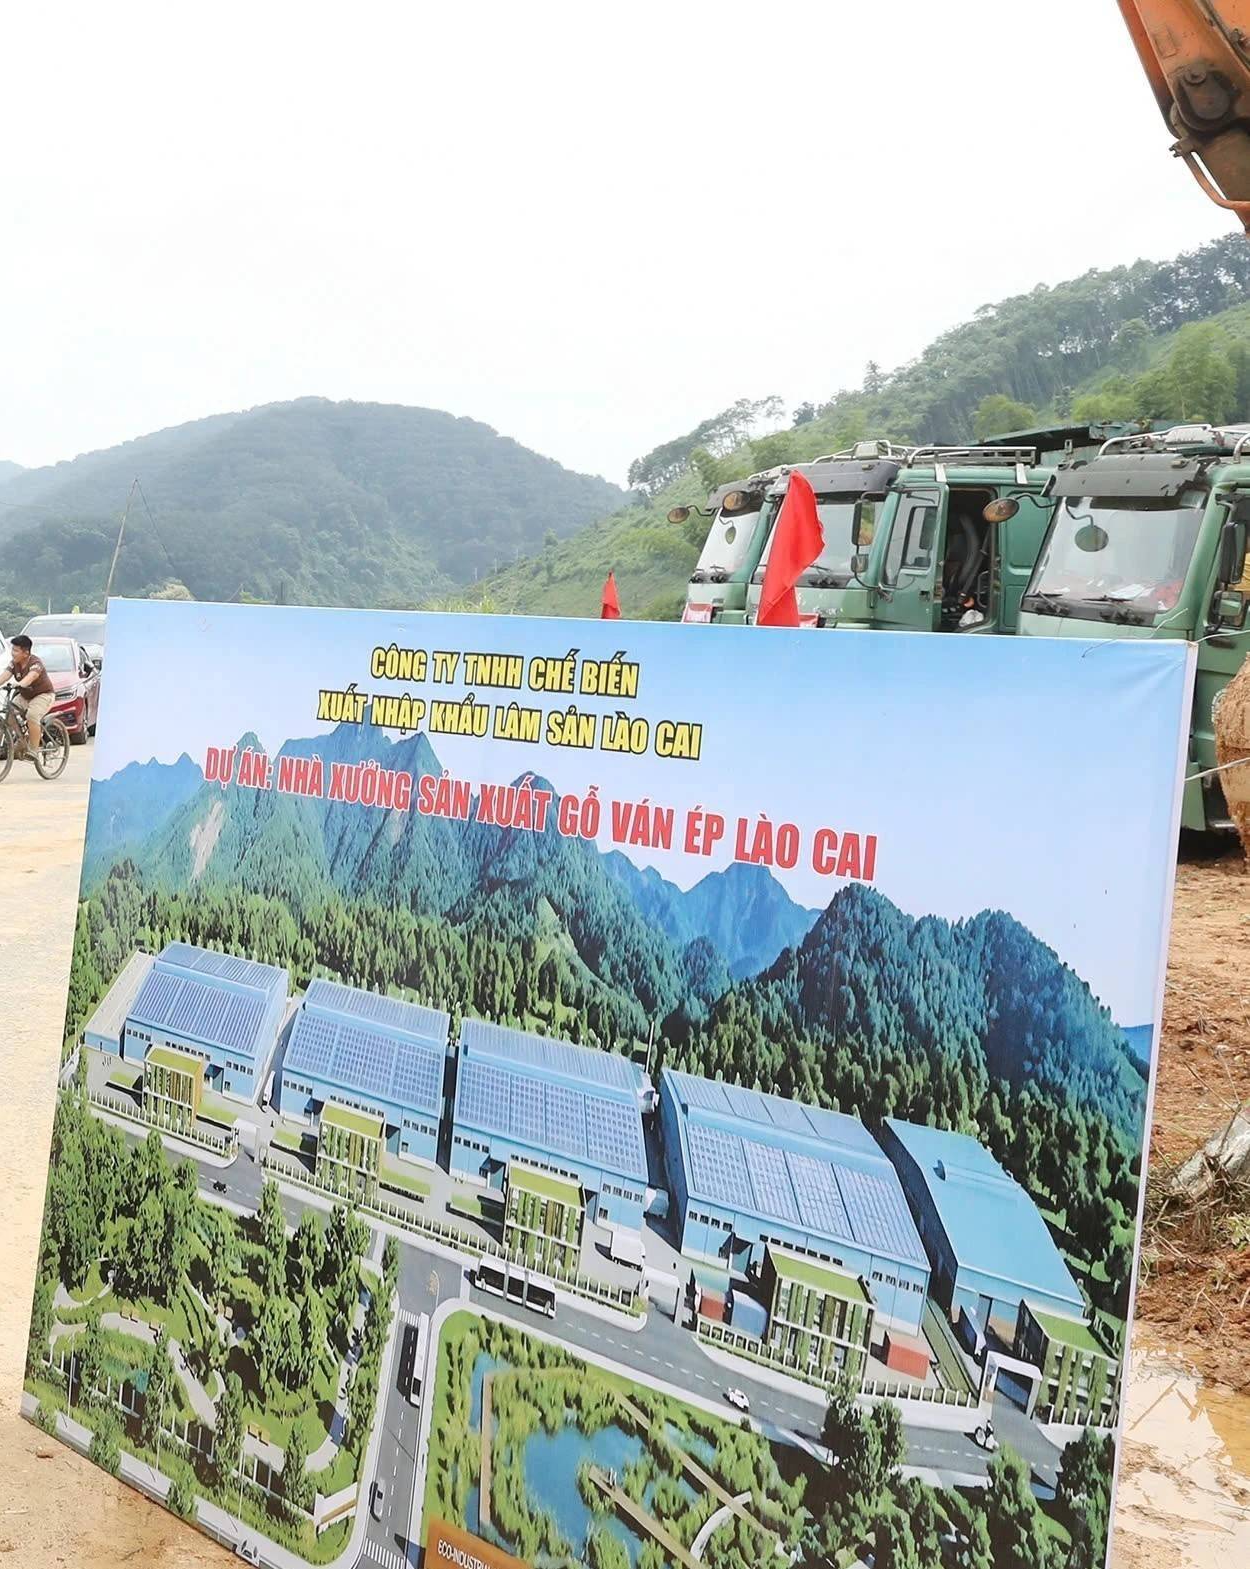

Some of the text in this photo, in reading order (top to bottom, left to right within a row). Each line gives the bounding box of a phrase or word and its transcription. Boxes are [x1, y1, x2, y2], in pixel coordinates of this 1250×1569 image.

[371, 643, 639, 698] CÔNG TY TNHH CHẾ BIẾN
[317, 683, 703, 760] XUẤT NHẬP KHẨU LÂM SẢN LÀO CAI
[204, 745, 878, 881] DỰ ÁN: NHÀ XƯỞNG SẢN XUẤT GỖ VÁN ÉP LÀO CAI
